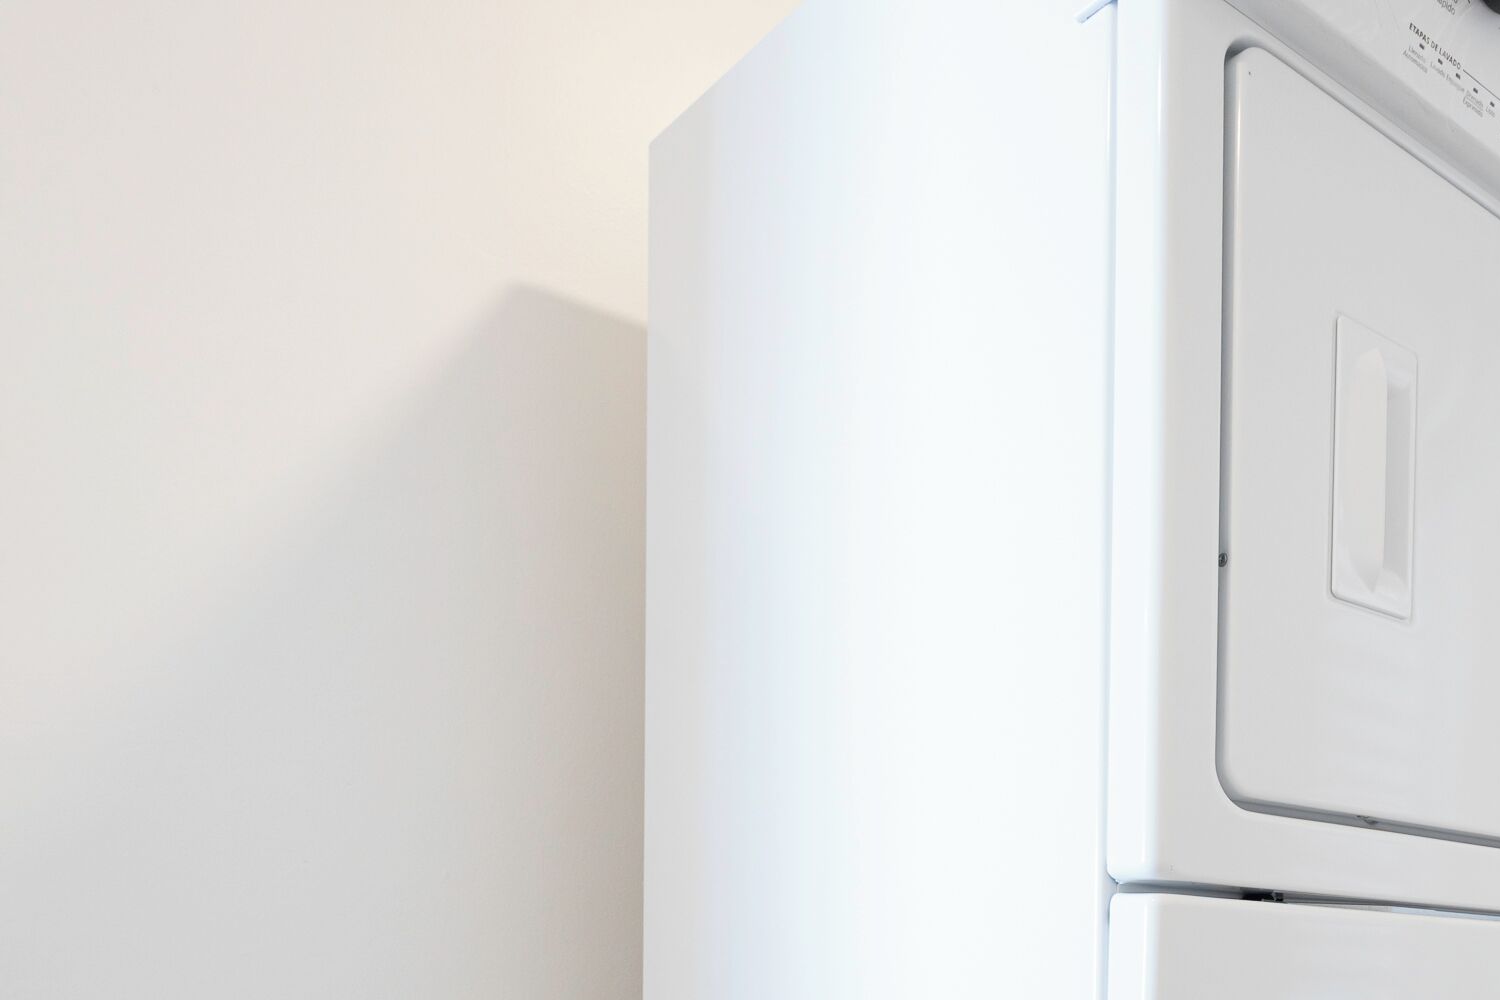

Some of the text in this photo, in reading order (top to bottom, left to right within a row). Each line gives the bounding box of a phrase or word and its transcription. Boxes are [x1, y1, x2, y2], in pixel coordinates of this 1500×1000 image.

[1409, 22, 1461, 70] ETAPAS DE LAVADO
